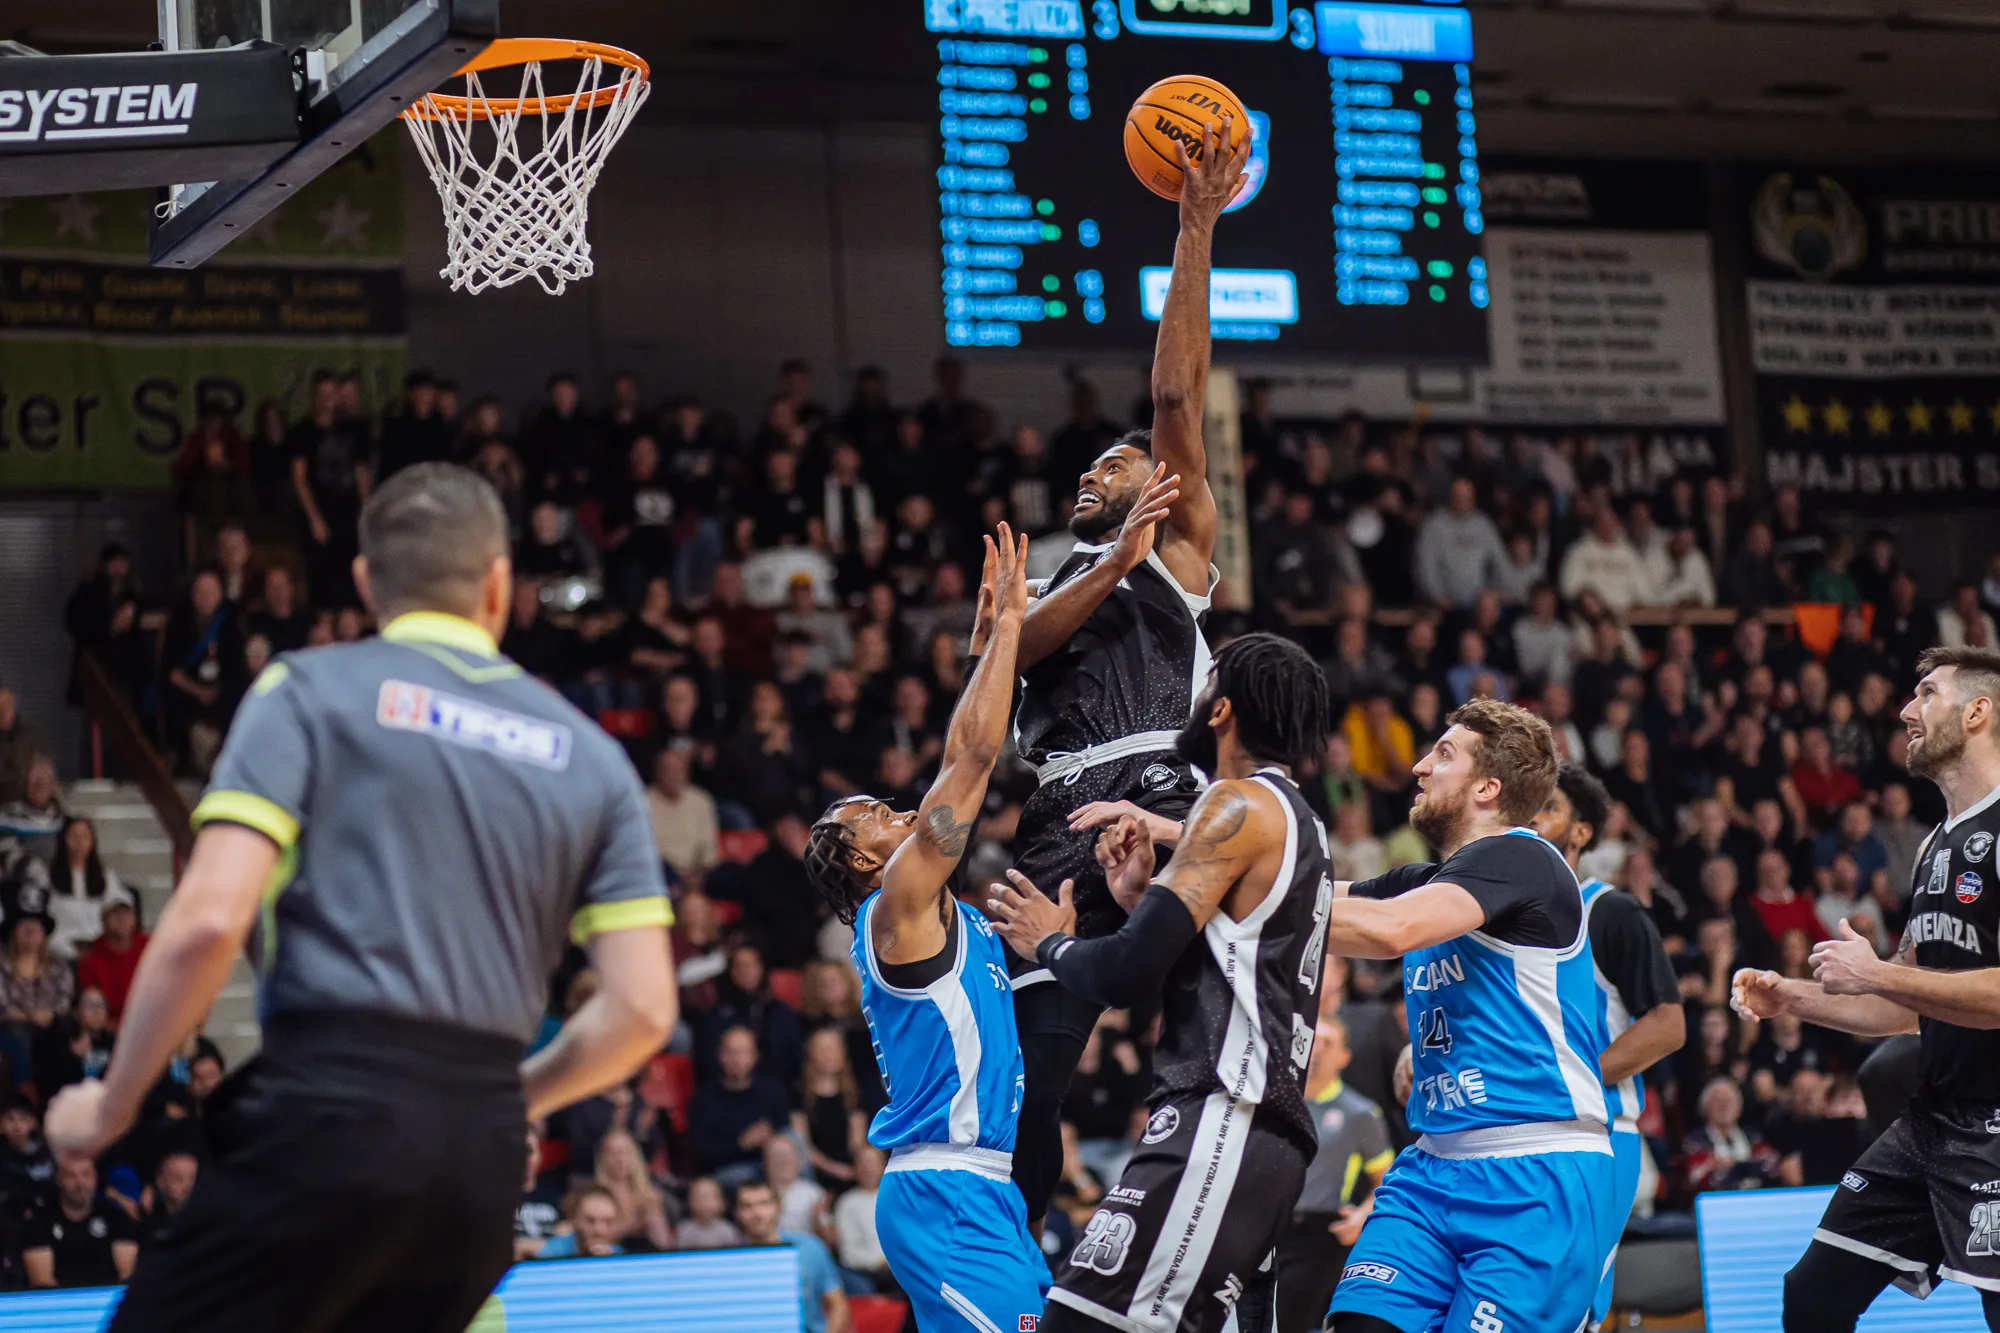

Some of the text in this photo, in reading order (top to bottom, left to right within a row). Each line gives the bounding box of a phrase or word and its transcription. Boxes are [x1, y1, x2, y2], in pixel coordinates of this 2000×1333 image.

[1290, 8, 1315, 49] 3
[0, 83, 197, 141] SYSTEM
[1766, 449, 1967, 495] MAJSTER
[1956, 884, 1979, 896] SBL
[1417, 1006, 1453, 1058] 14
[1218, 1121, 1229, 1140] ARE
[1214, 1139, 1225, 1154] WE
[1197, 1160, 1219, 1204] PRIEVIDZA
[1191, 1203, 1205, 1222] ARE
[1185, 1221, 1197, 1237] WE
[1070, 1208, 1137, 1276] 23
[1163, 1244, 1189, 1286] PRIEVIDZA
[1346, 1264, 1393, 1281] TIPOS
[1156, 1284, 1170, 1303] ARE
[1150, 1301, 1162, 1317] WE
